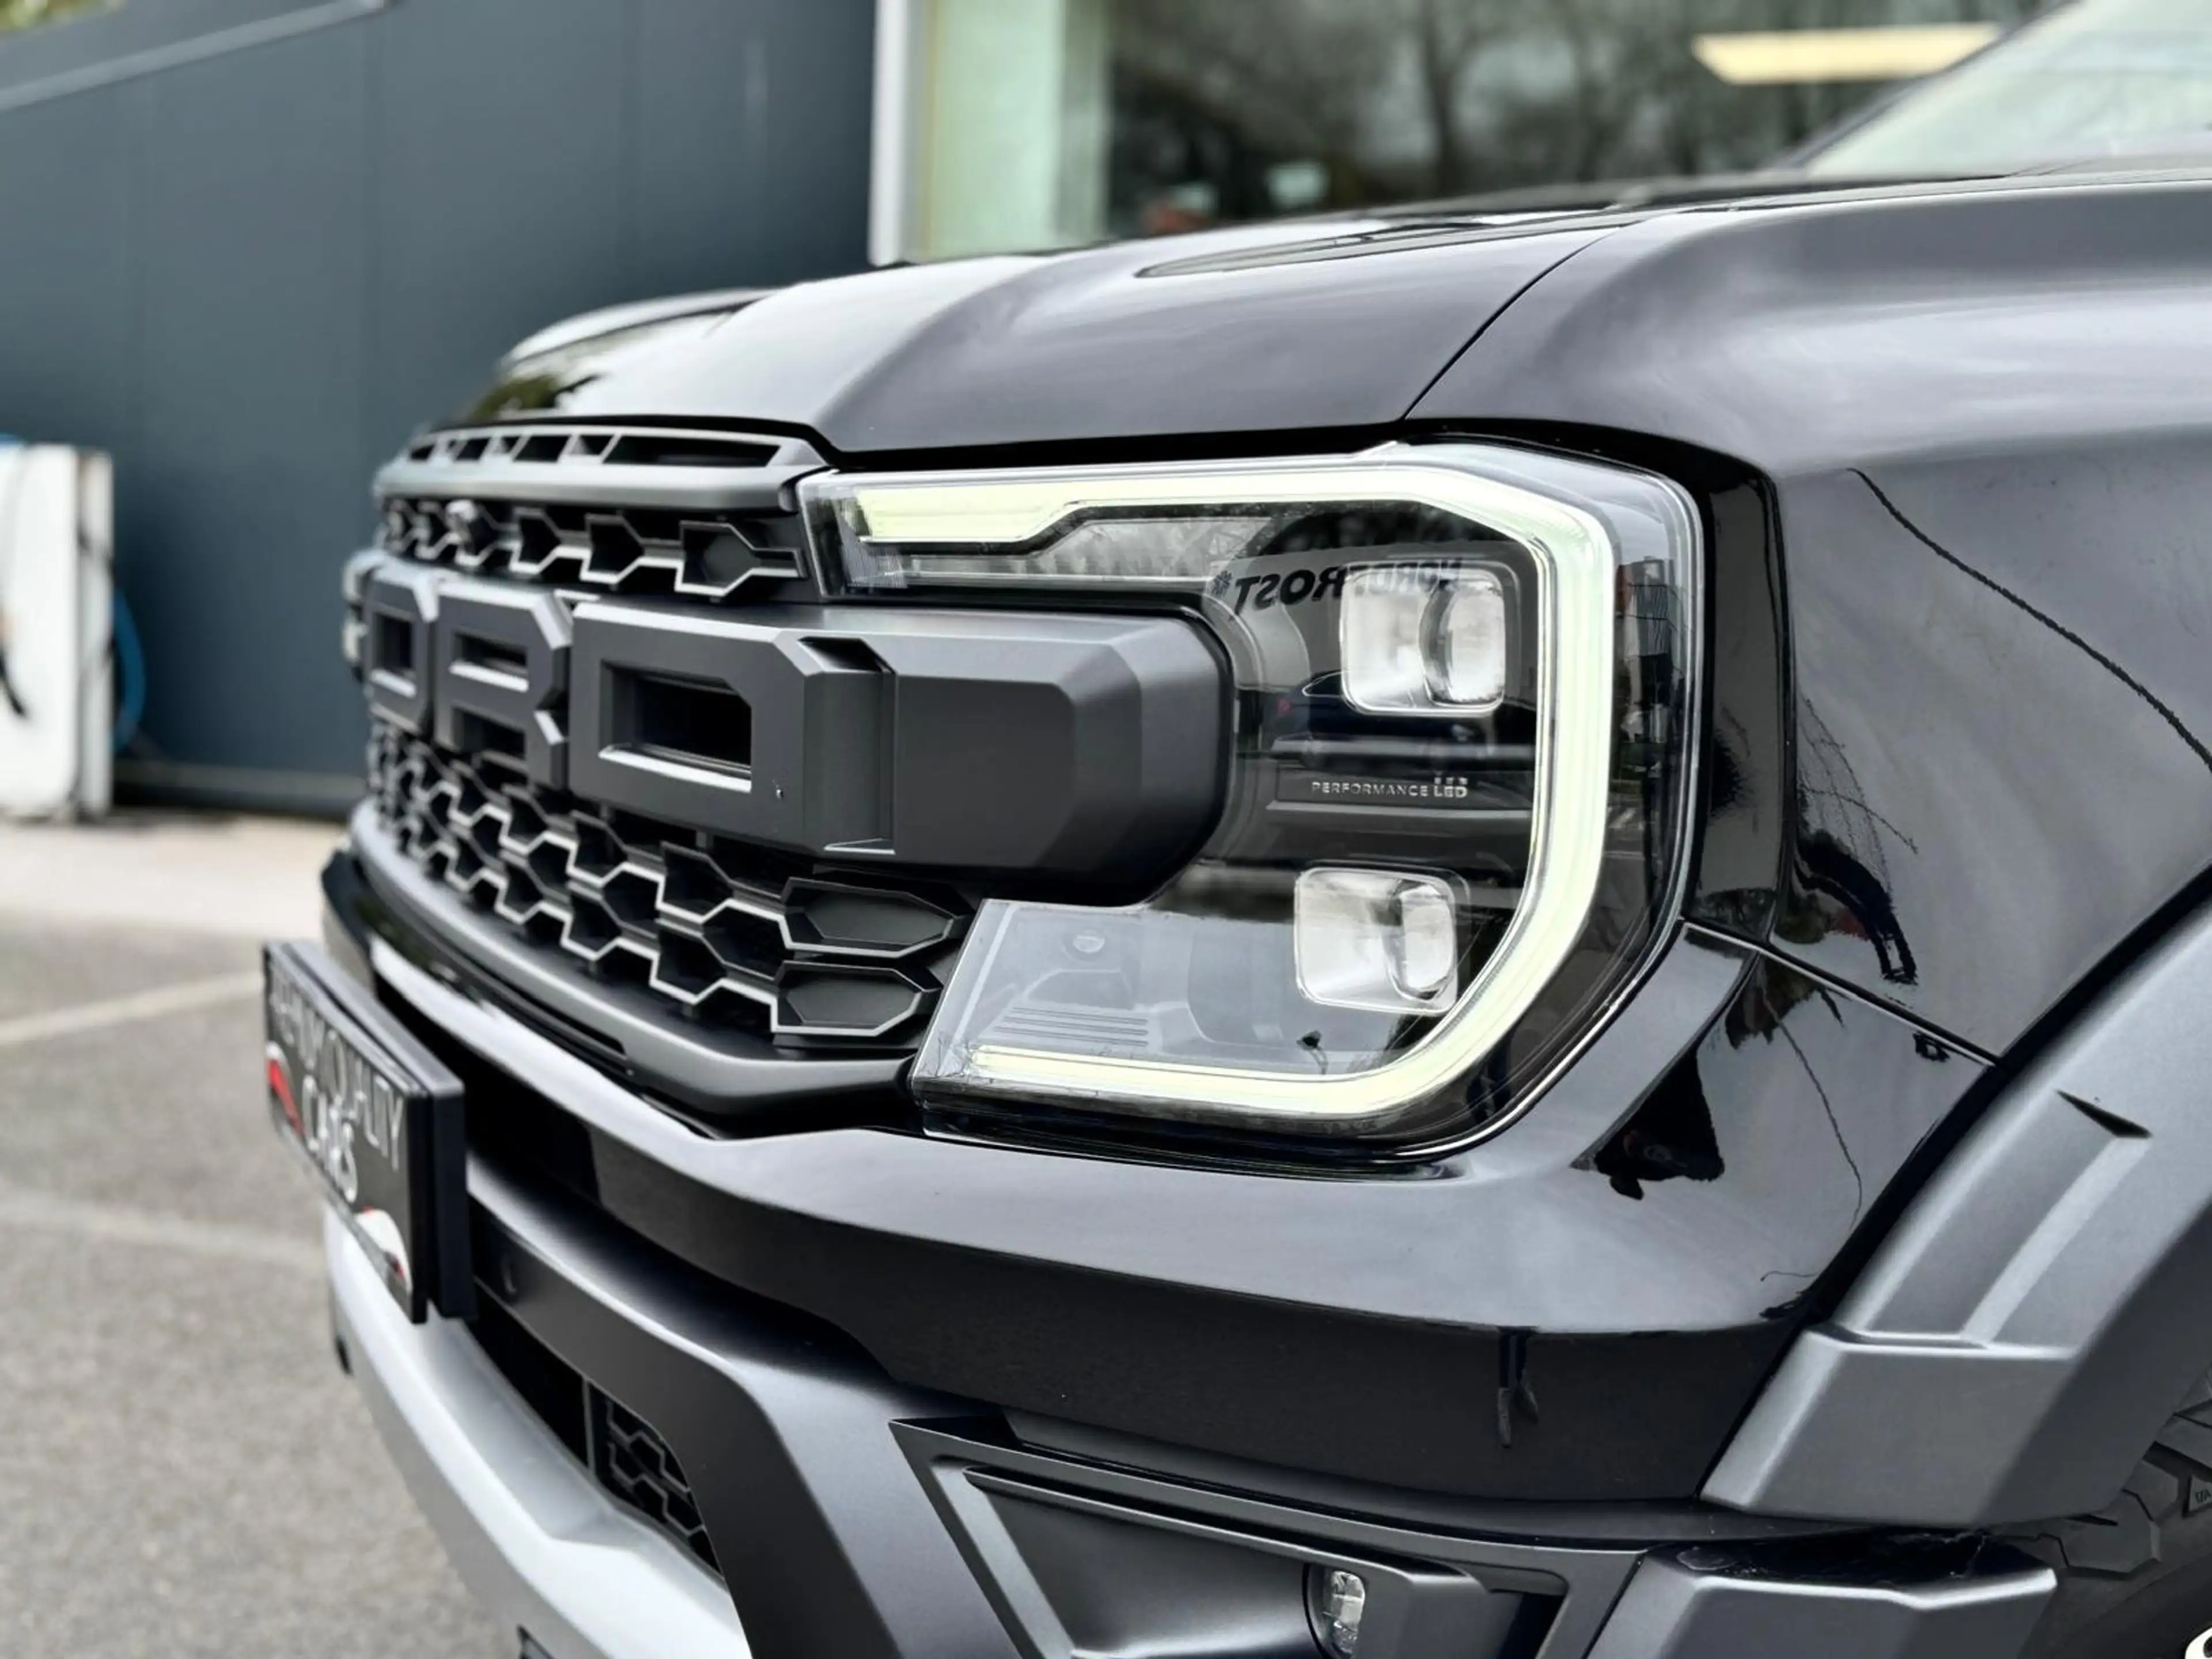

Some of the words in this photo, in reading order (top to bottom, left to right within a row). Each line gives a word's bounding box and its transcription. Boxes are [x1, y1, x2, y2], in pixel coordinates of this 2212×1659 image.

[343, 551, 812, 830] ORD
[1312, 782, 1429, 797] PERFORMANCE
[1433, 785, 1468, 798] LED
